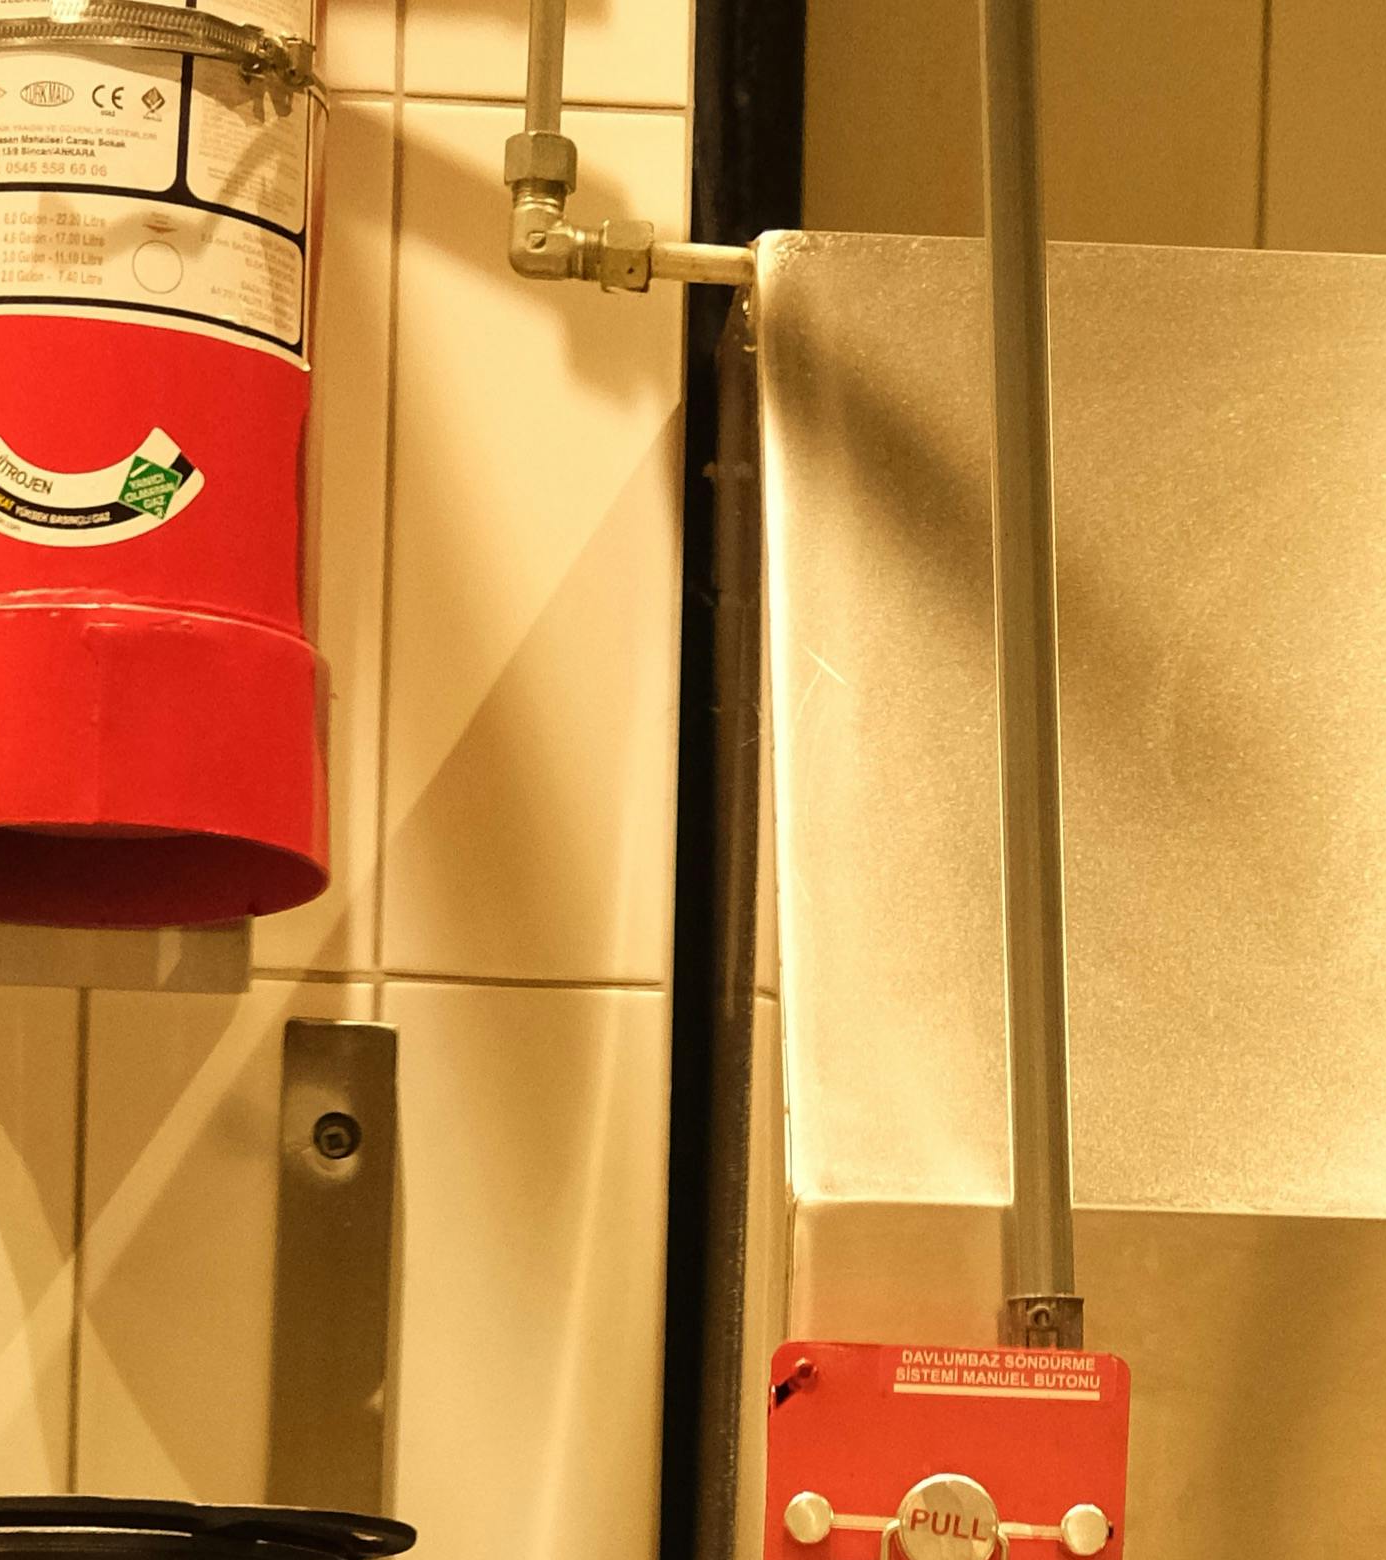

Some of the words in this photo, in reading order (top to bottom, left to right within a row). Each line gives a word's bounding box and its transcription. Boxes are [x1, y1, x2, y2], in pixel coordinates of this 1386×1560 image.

[901, 1350, 1000, 1368] DAVLUMBAZ
[1004, 1352, 1095, 1372] SÖNDÜRME
[895, 1365, 958, 1384] SİSTEMİ
[962, 1370, 1029, 1387] MANUEL
[1033, 1373, 1100, 1390] BUTONU
[910, 1508, 988, 1542] PULL
